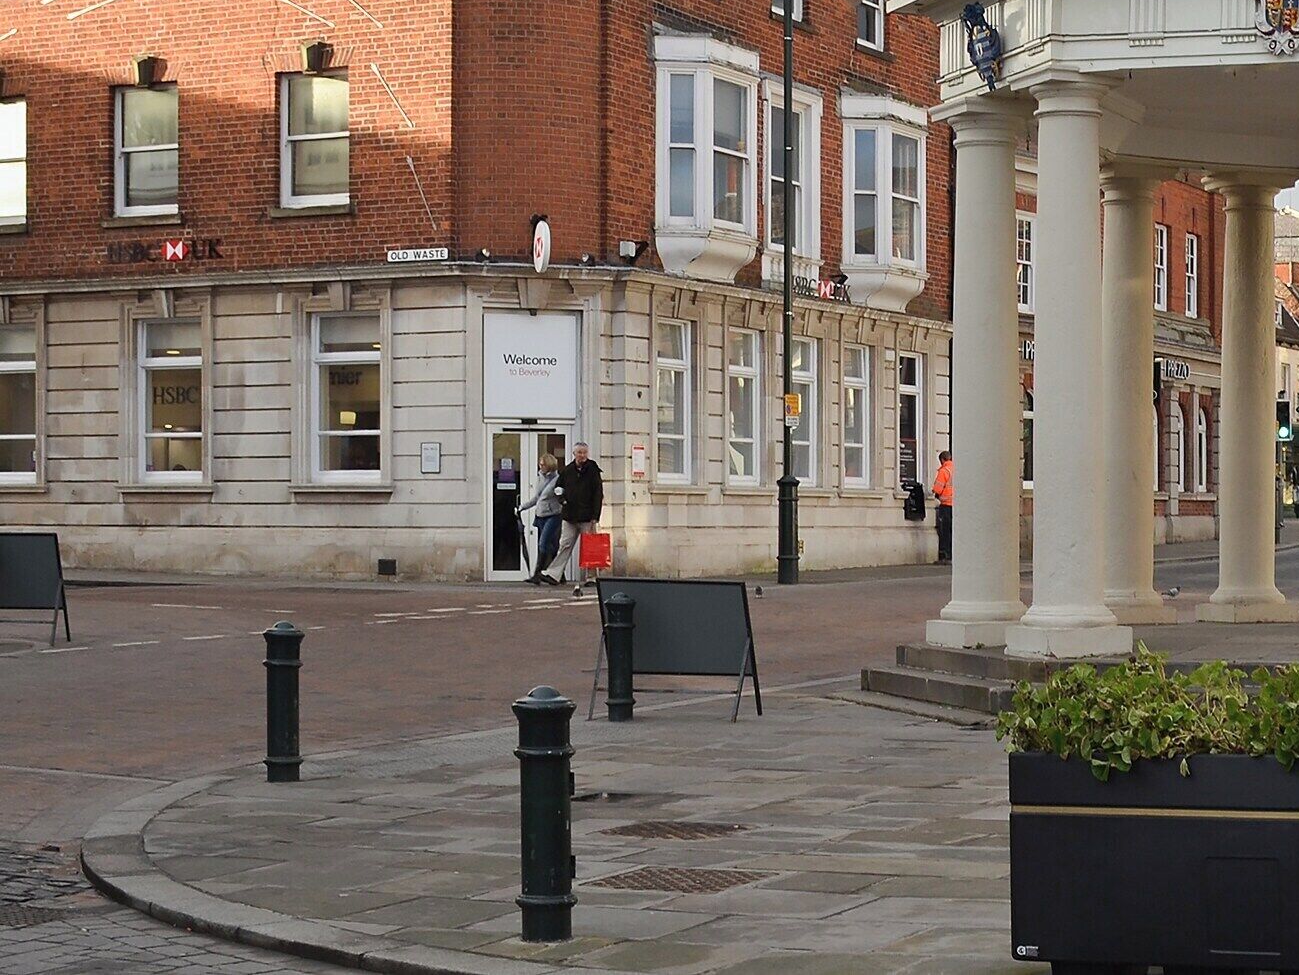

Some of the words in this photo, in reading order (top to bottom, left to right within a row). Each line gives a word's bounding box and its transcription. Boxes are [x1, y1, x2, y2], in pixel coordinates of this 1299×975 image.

[390, 251, 409, 261] OLD
[412, 249, 446, 260] WASTE
[502, 353, 558, 366] Welcome
[509, 368, 518, 377] to
[1164, 359, 1191, 380] PREZZO
[152, 385, 199, 405] HSBC
